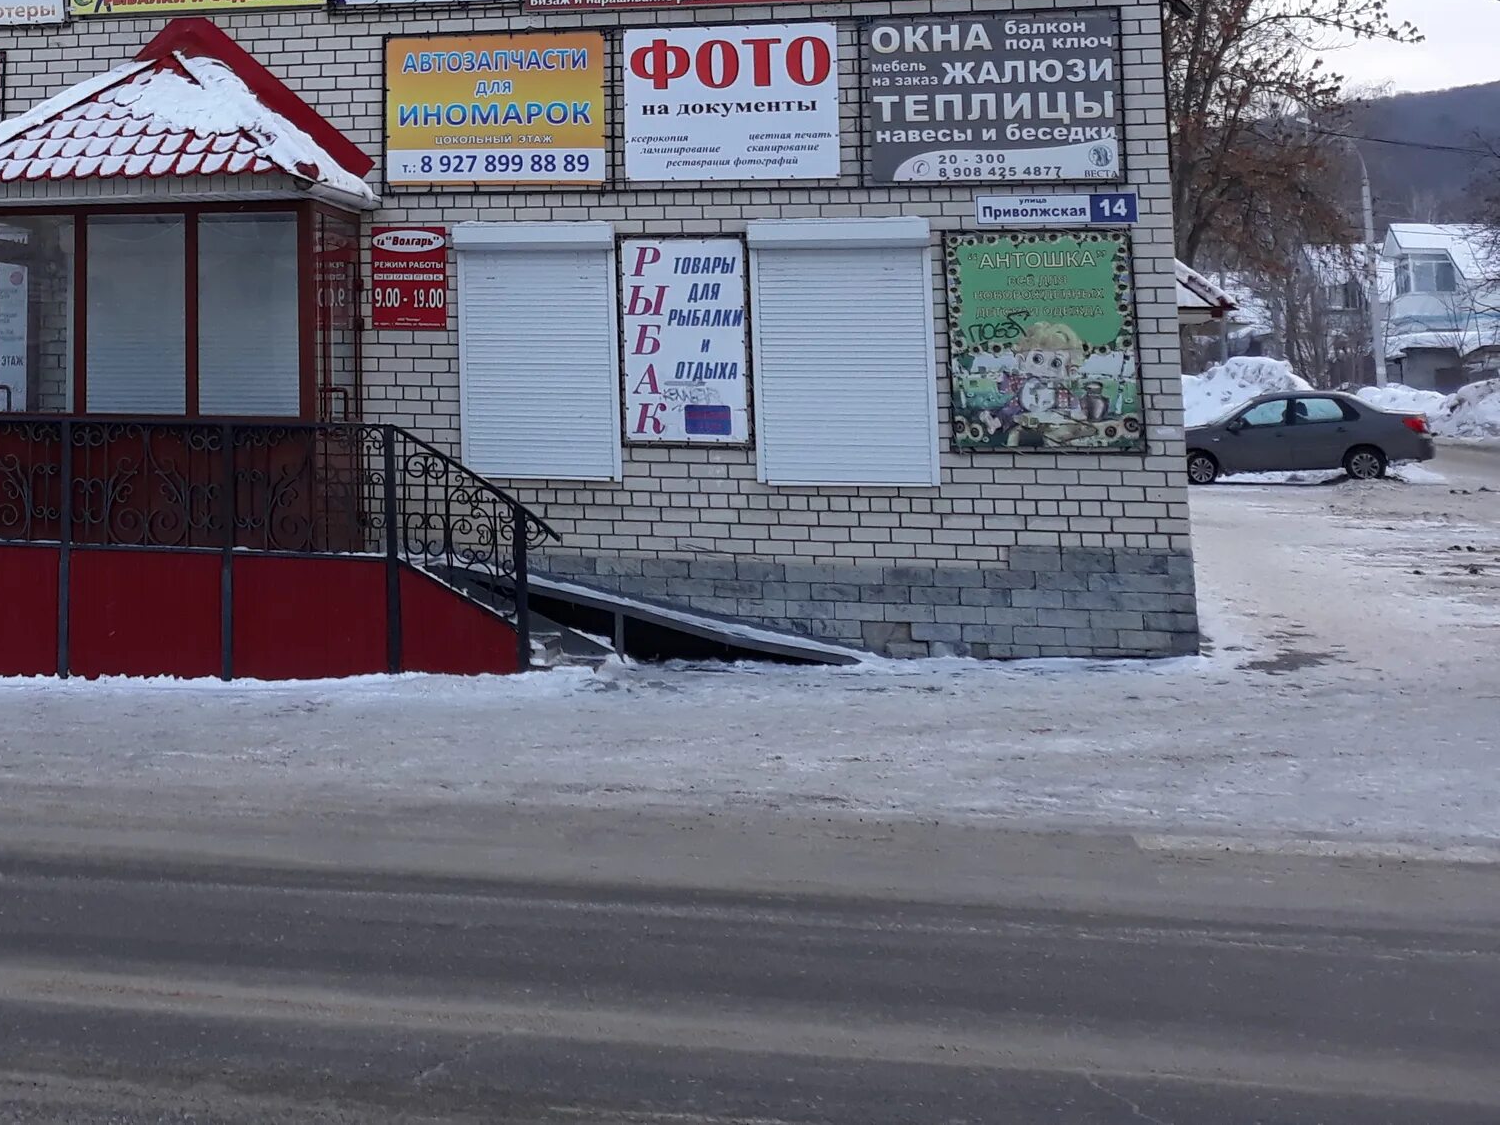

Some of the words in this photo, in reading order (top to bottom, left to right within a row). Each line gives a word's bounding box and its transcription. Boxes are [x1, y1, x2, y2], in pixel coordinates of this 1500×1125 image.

[1005, 20, 1086, 34] балкон
[871, 24, 993, 54] ОКНА
[1005, 38, 1045, 51] под
[1052, 36, 1112, 49] ключ
[402, 48, 588, 74] АВТОЗАПЧАСТИ
[630, 36, 831, 90] ФОТО
[872, 61, 926, 72] мебель
[942, 58, 1112, 85] ЖАЛЮЗИ
[475, 80, 512, 97] для
[399, 101, 591, 126] ИНОМАРОК
[642, 104, 669, 115] на
[677, 100, 817, 117] документы
[873, 91, 1114, 124] ТЕПЛИЦЫ
[435, 134, 512, 145] ЦОКОЛЬНЫЙ
[518, 135, 552, 143] ЭТАЖ
[631, 134, 688, 144] ксерокопия
[876, 127, 972, 143] навесы
[982, 129, 996, 141] и
[1006, 124, 1117, 142] беседки
[640, 145, 720, 155] ламинирование
[747, 144, 819, 152] сканирование
[421, 156, 432, 172] 8
[440, 155, 477, 172] 927
[484, 155, 523, 172] 899
[530, 154, 556, 172] 88
[564, 154, 589, 172] 89
[939, 168, 946, 177] 8
[953, 167, 981, 176] 908
[988, 167, 1016, 176] 425
[1023, 167, 1062, 177] 4877
[1084, 170, 1119, 178] ВЕСТА
[982, 206, 1086, 220] Приволжская
[1100, 198, 1127, 217] 14
[674, 257, 736, 275] ТОВАРЫ
[375, 288, 400, 307] 9.00
[413, 288, 443, 307] 19.00
[688, 283, 721, 303] ДЛЯ
[668, 309, 743, 327] РЫБАЛКИ
[624, 247, 670, 434] РЫБАК
[701, 339, 710, 352] И
[2, 356, 23, 366] ЭТАЖ
[675, 362, 737, 381] ОТДЫХА
